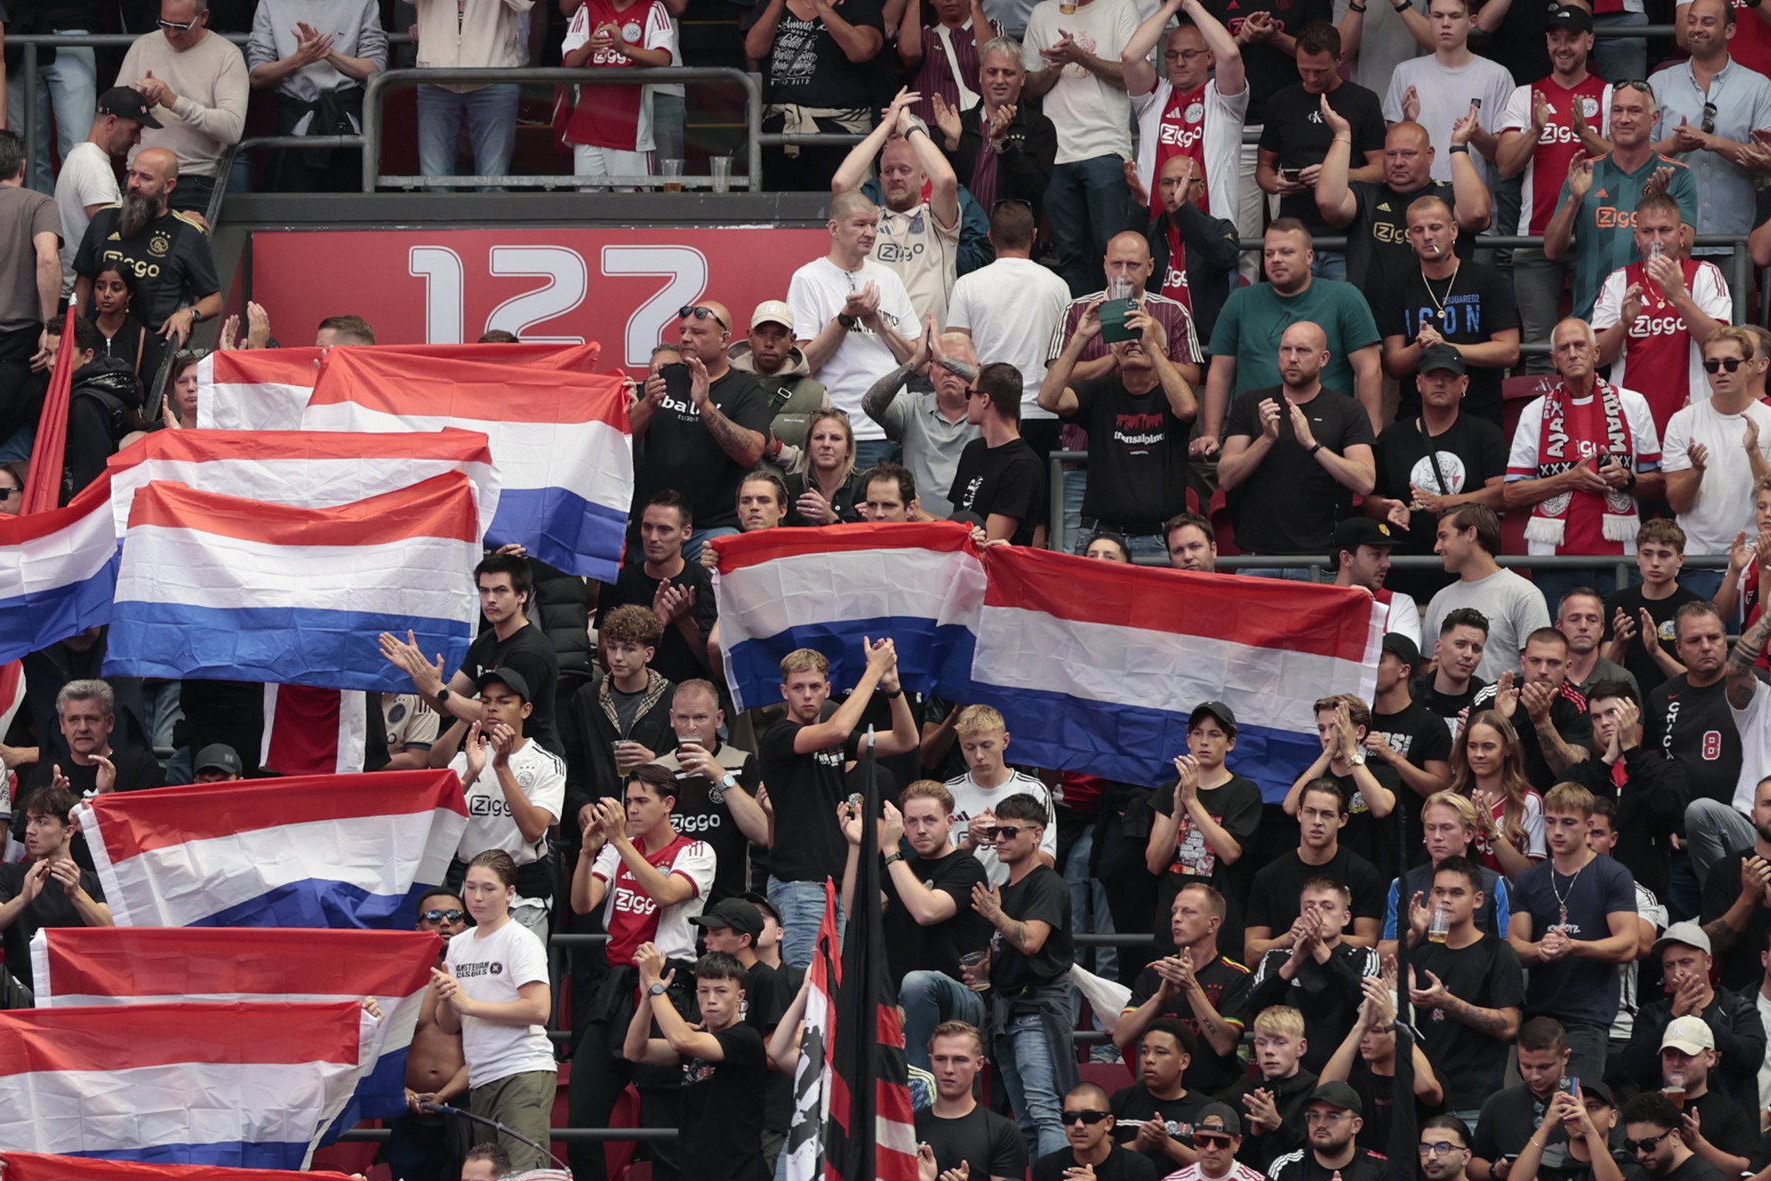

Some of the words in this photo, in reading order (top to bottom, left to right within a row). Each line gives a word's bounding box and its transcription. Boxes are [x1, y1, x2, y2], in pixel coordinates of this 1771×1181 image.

[594, 47, 631, 65] Zigg
[409, 245, 708, 367] 127
[1404, 305, 1481, 339] ICON
[1114, 429, 1165, 446] transalpino
[1546, 399, 1569, 458] AJAX
[1702, 731, 1723, 761] 8
